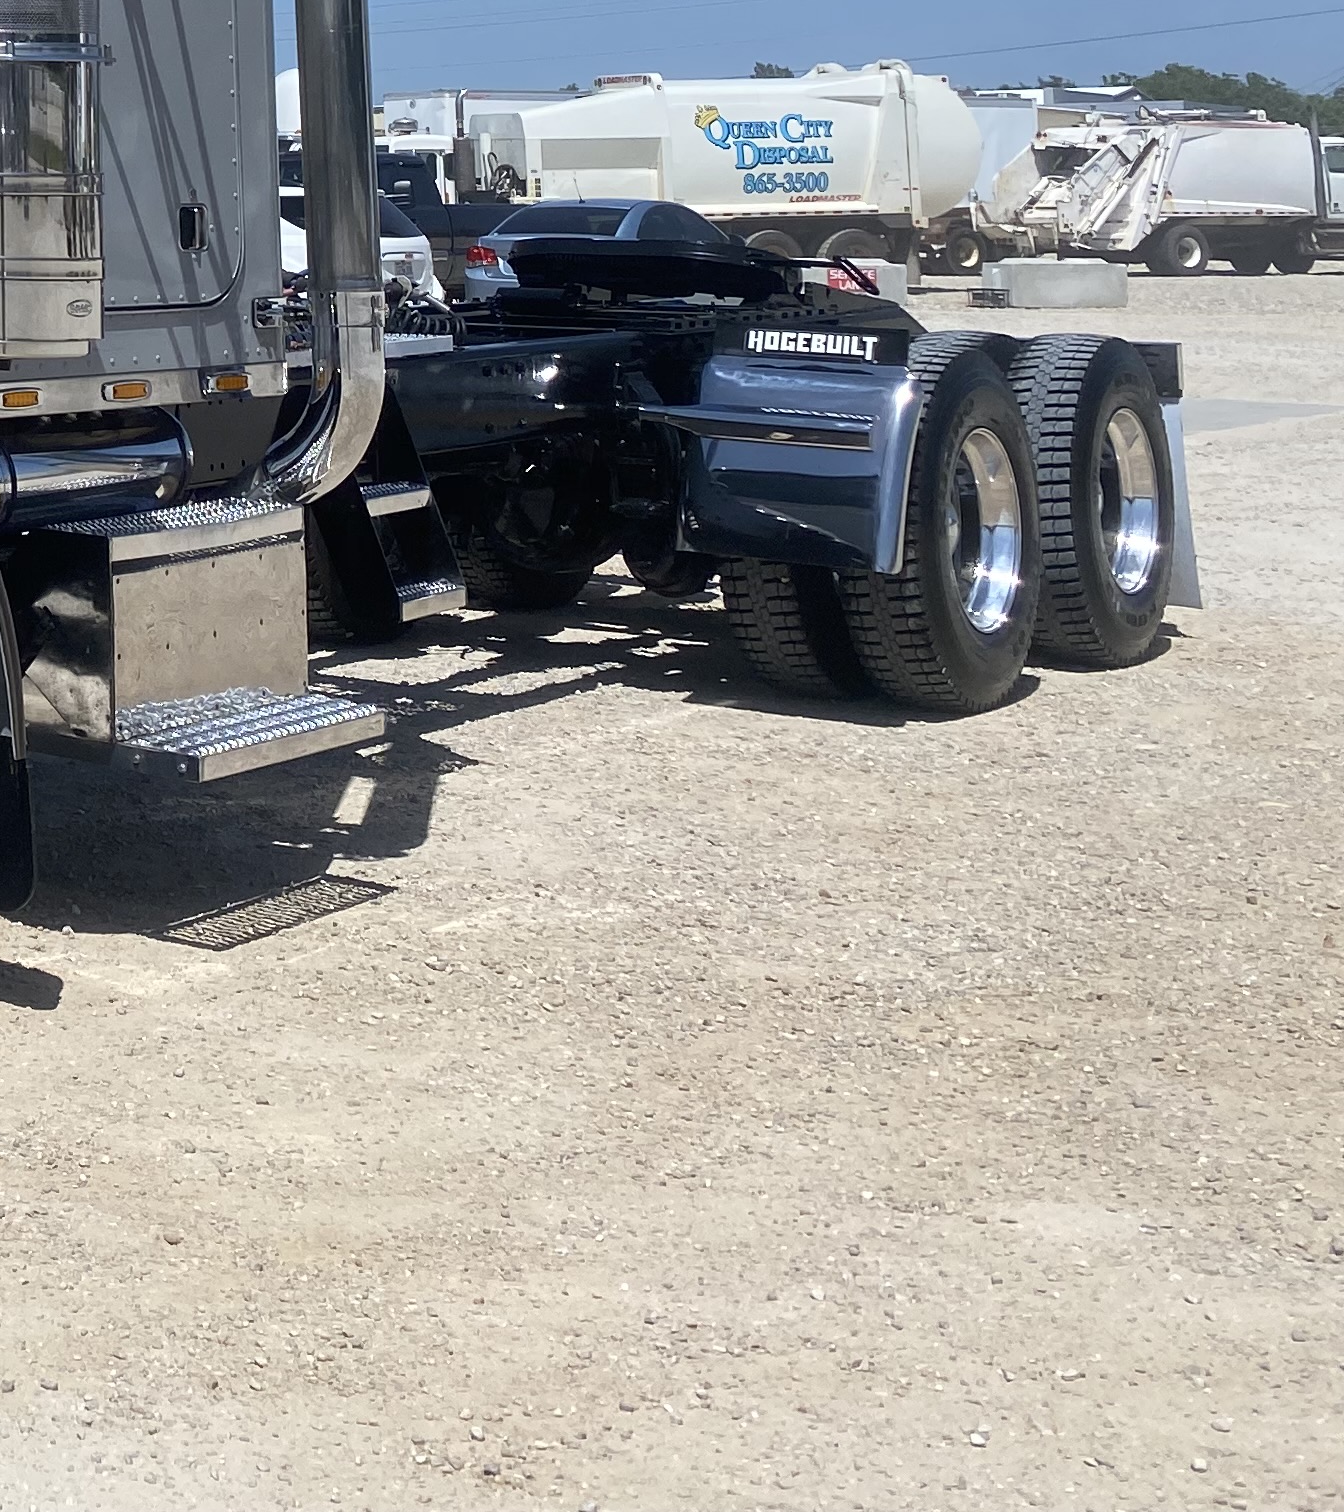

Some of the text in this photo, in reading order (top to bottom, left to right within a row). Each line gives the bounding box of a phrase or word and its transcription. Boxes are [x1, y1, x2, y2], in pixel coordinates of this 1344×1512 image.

[703, 113, 834, 150] QUEEN CITY
[733, 140, 834, 170] DISPOSAL
[743, 171, 829, 194] 865-3500
[789, 194, 862, 203] LOADMASTER
[747, 330, 879, 361] HOGEBUILT
